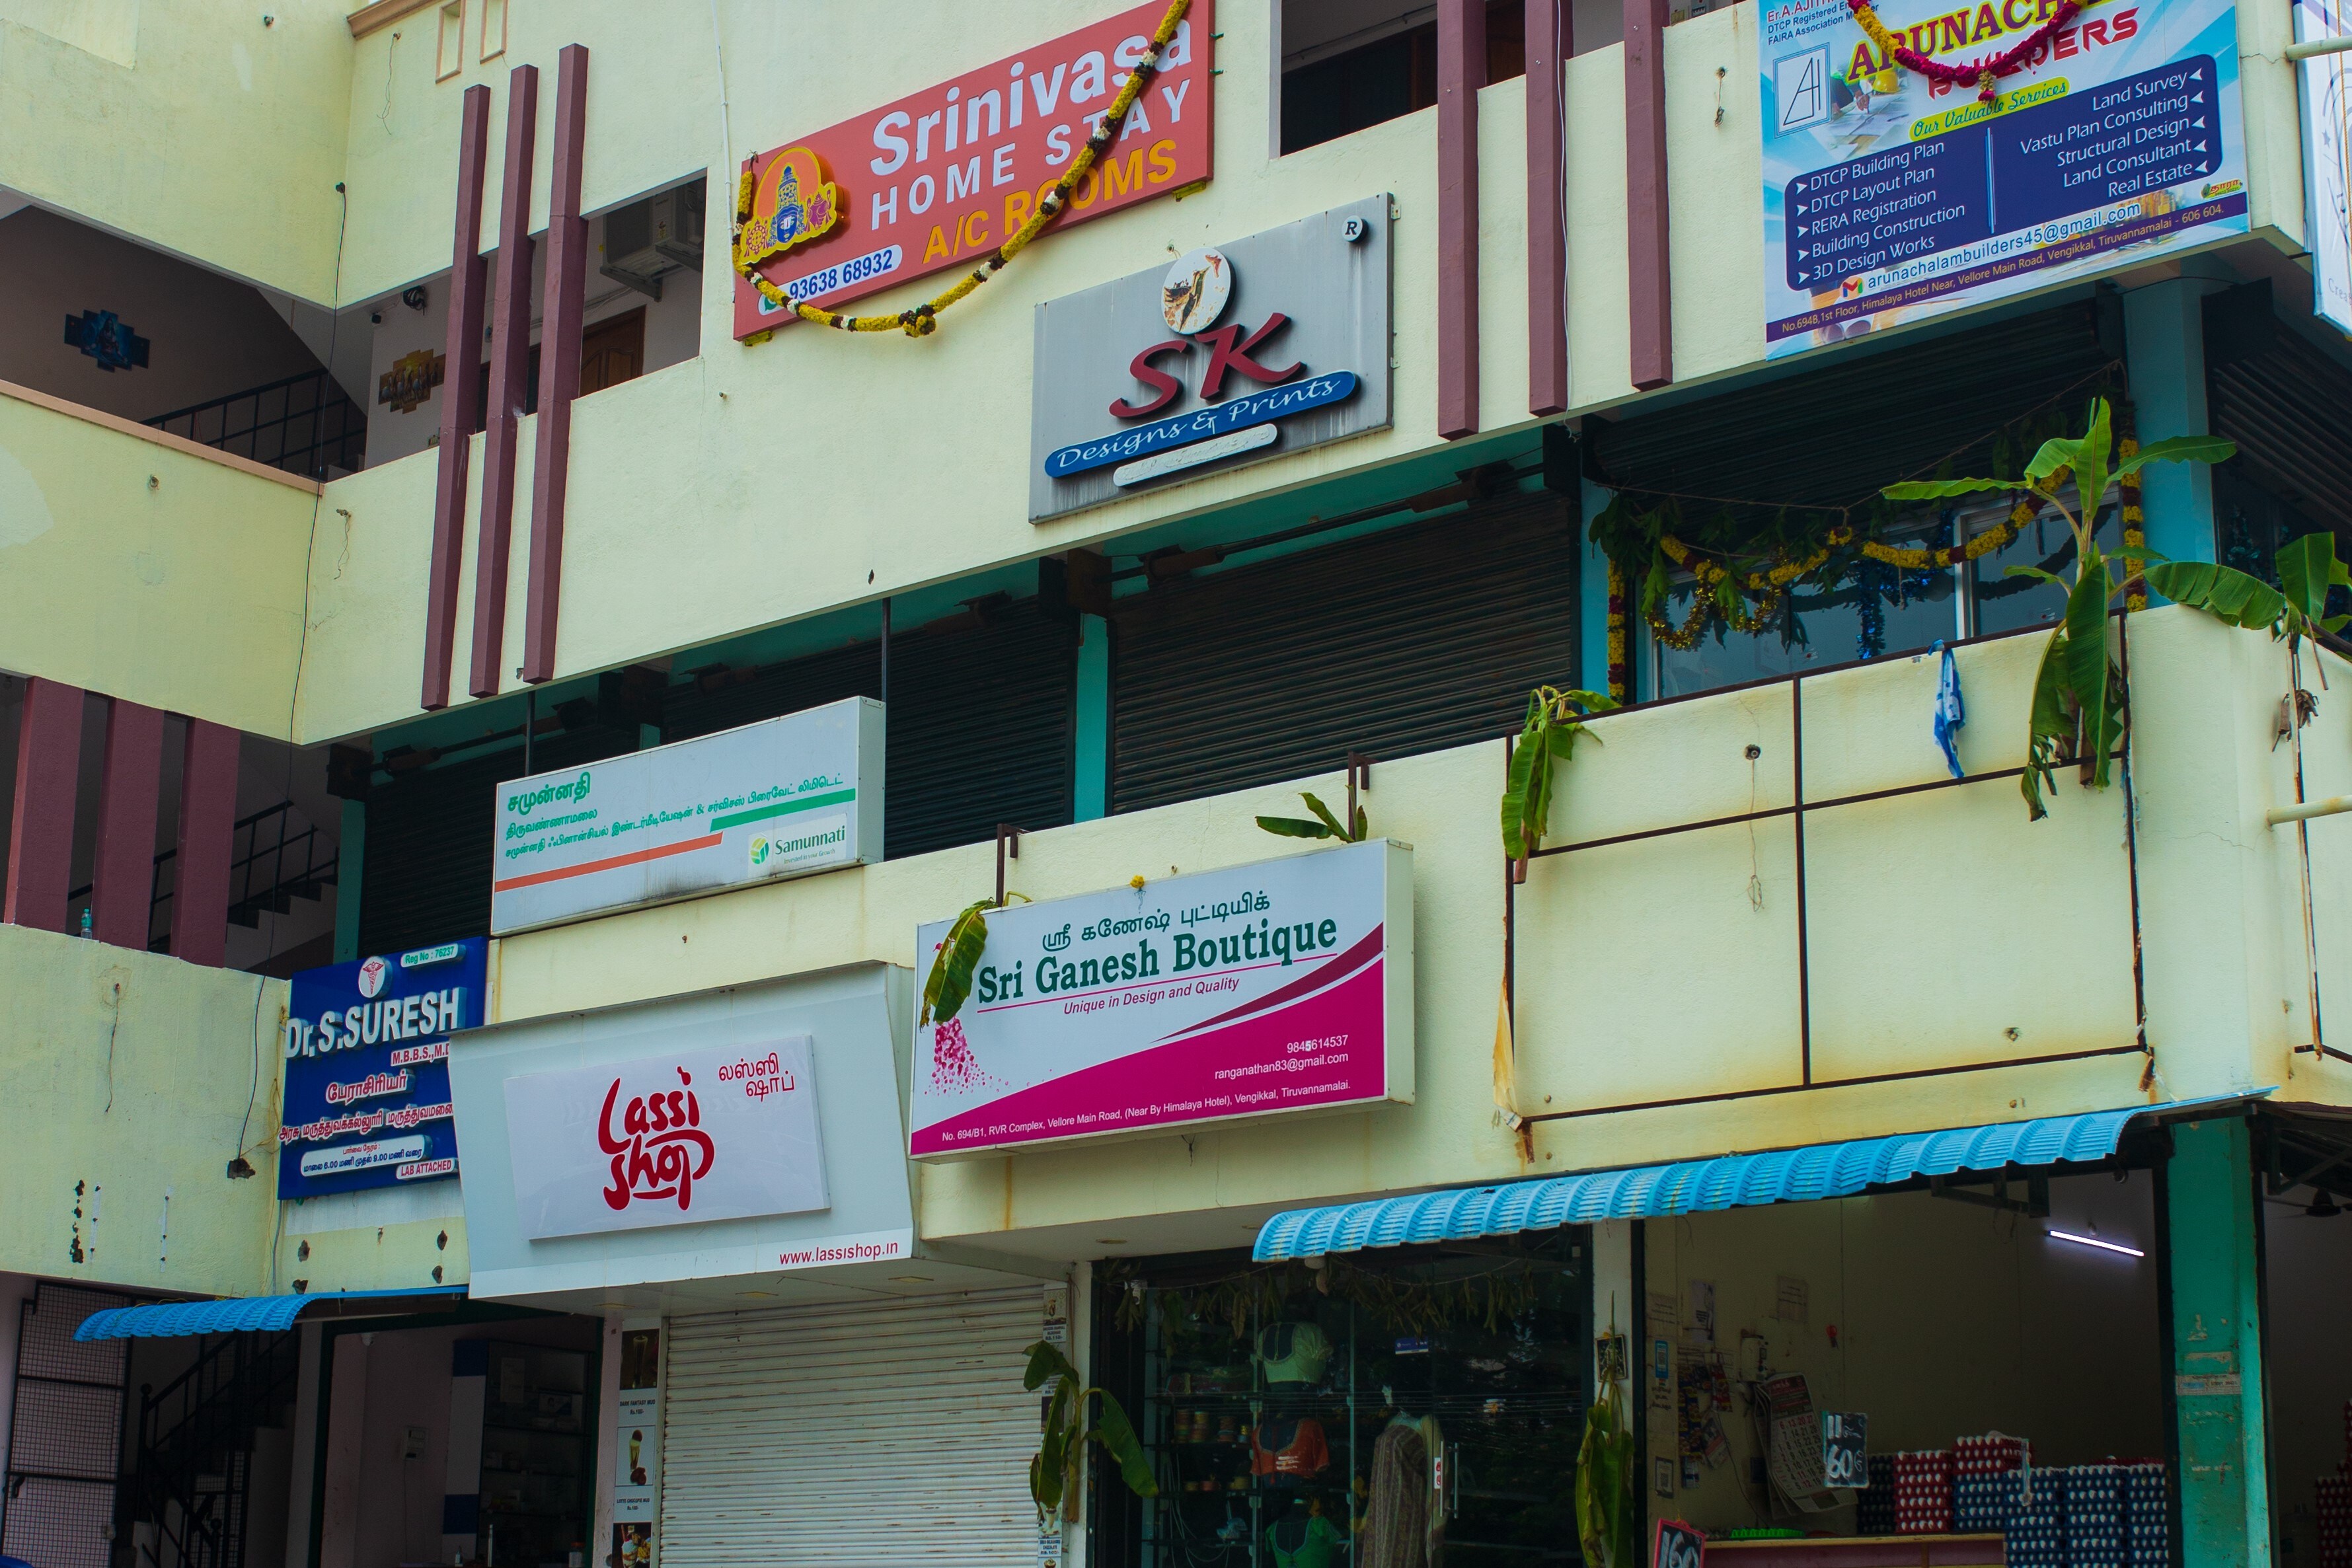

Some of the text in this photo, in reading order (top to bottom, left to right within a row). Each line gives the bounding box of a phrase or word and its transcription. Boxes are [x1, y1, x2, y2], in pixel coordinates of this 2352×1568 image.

[1768, 19, 1791, 34] DTCP
[1793, 5, 1837, 26] Registered
[1768, 15, 1843, 46] FAIRA Association
[870, 19, 1192, 176] Srinivasa
[1913, 82, 2067, 137] Our Valuable Services
[2093, 71, 2188, 112] Land Survey
[2020, 93, 2189, 155] Vastu Plan Consulting
[2057, 116, 2190, 167] Structural Design
[871, 78, 1192, 231] HOME STAY
[1811, 141, 1944, 192] DTCP Building Plan
[2063, 137, 2192, 188] Land Consultant
[923, 138, 1176, 264] A/C ROOMS
[1811, 167, 1935, 213] DTCP Layout Plan
[2108, 161, 2193, 198] Real Estate
[1344, 221, 1358, 237] R
[1812, 190, 1936, 235] RERA Registration
[1813, 205, 1965, 258] Building Construction
[1813, 235, 1935, 281] 3D Design Works
[1835, 303, 1860, 319] Floor,
[1862, 289, 1903, 311] Himalaya
[1905, 285, 1929, 299] Hotel
[1932, 279, 1956, 293] Near,
[1957, 270, 1991, 285] Vellore
[1992, 262, 2016, 279] Main
[2018, 253, 2045, 269] Road,
[2047, 241, 2096, 262] Vengikkal,
[2098, 217, 2172, 247] Tiruvannamalai
[2181, 209, 2201, 224] 606
[1868, 202, 2141, 289] arunachalambuilders45@gmail.com
[789, 249, 893, 299] 93638 68932
[1109, 313, 1307, 418] SK
[1057, 420, 1187, 468] Designs
[1228, 377, 1342, 422] Prints
[507, 771, 591, 815] சமுன்னதி
[505, 838, 546, 859] சமுன்னதி
[696, 803, 704, 815] &
[506, 808, 598, 840] திருவண்ணாமலை
[775, 825, 846, 855] Samunnati
[1081, 908, 1170, 942] கணேஷ்
[1180, 890, 1270, 926] புட்டியிக்
[404, 953, 418, 965] Reg
[419, 952, 429, 961] No
[435, 946, 455, 957] 76237
[977, 916, 1338, 1004] Sri Ganesh Boutique
[1063, 976, 1240, 1016] Unique in Design and Quality
[718, 1052, 779, 1082] லஸ்ஸி
[1215, 1053, 1349, 1080] ranganathan83@gmail.com
[1286, 1035, 1349, 1054] 9845614537
[328, 1068, 408, 1104] பேராசிரியர்
[745, 1070, 795, 1102] ஷாப்
[597, 1066, 701, 1155] Lassi
[942, 1079, 1351, 1142] No. 694/B1, RVR Complex, Vellore Main Road, (Near By Himalaya Hotel), Vengikkal, Tiruvannamalai.
[279, 1126, 300, 1144] அரசு
[324, 1160, 338, 1170] 6.00
[338, 1156, 355, 1168] மணி
[389, 1148, 404, 1160] மணி
[400, 1160, 451, 1177] LAB ATTACHED
[780, 1240, 899, 1265] www.lassishop.in
